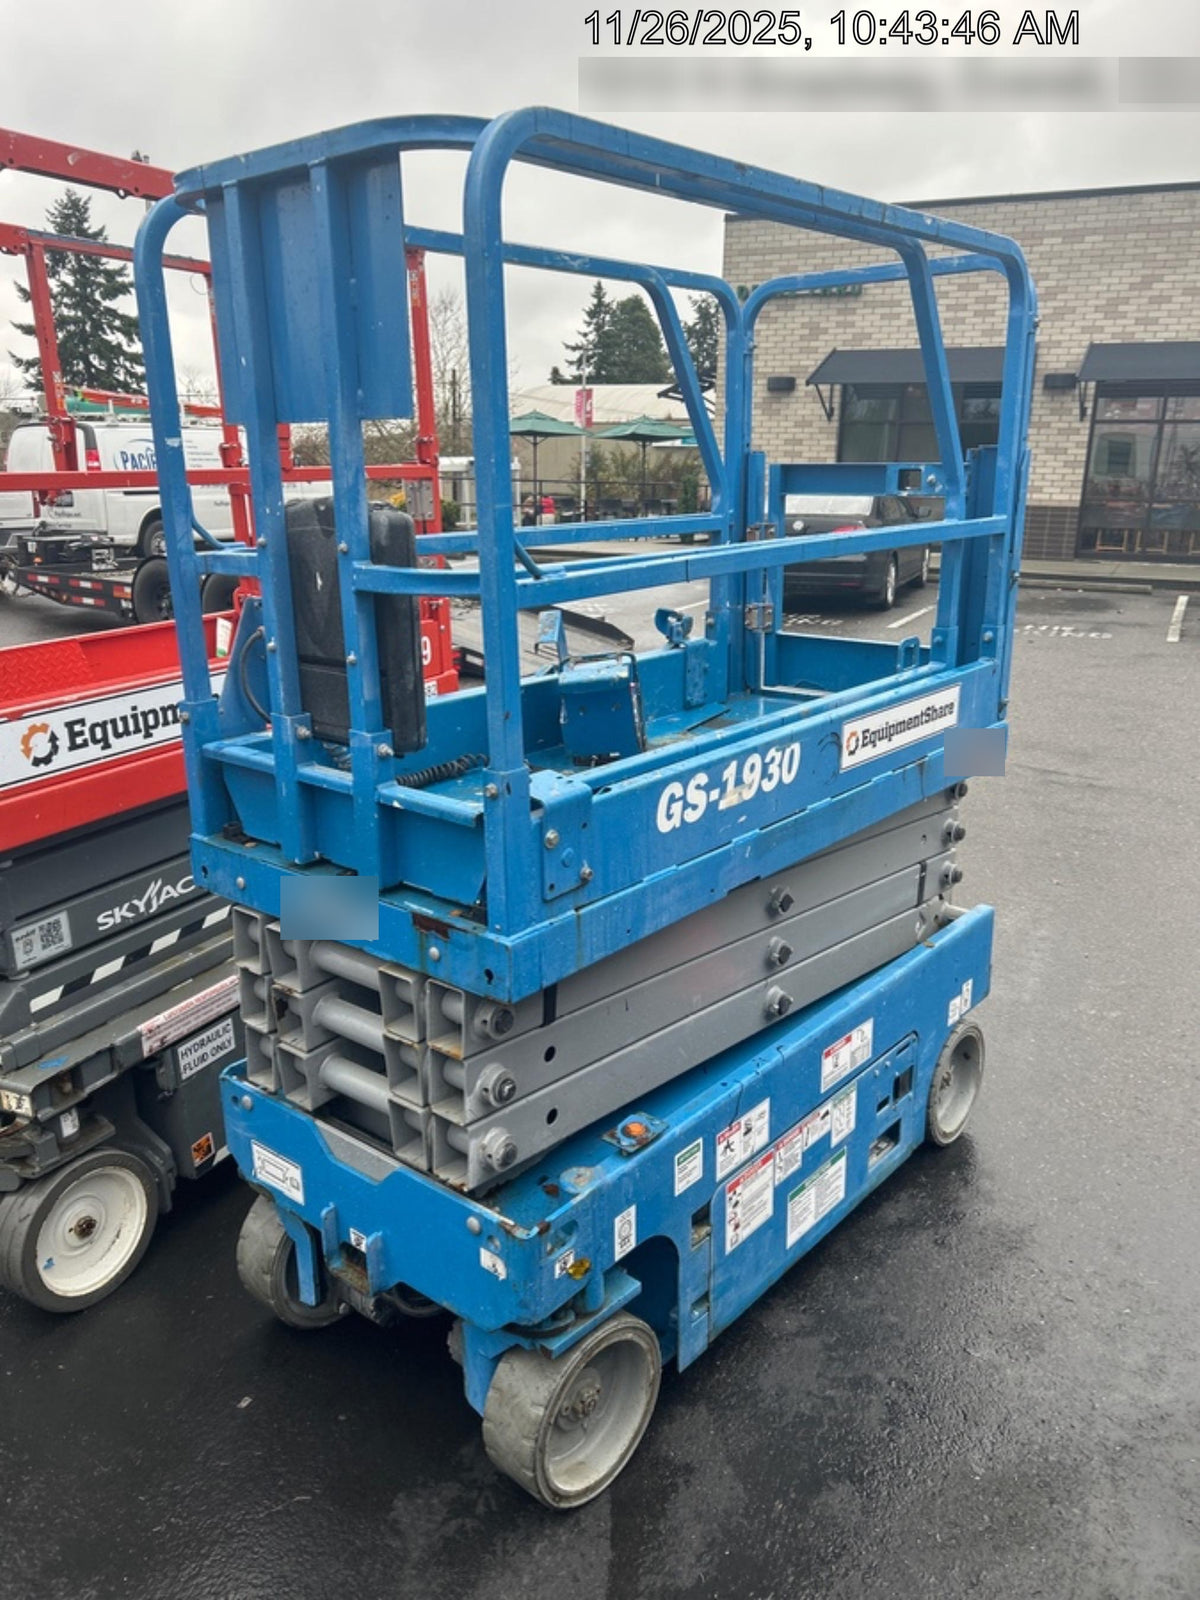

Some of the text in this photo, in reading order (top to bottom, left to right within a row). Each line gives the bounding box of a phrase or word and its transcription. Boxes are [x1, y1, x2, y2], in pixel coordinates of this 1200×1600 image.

[861, 700, 955, 750] EquipmentShare
[656, 742, 801, 834] GS-1930
[180, 1022, 231, 1060] HYDRAULIC
[182, 1037, 232, 1074] FLUID ONLY
